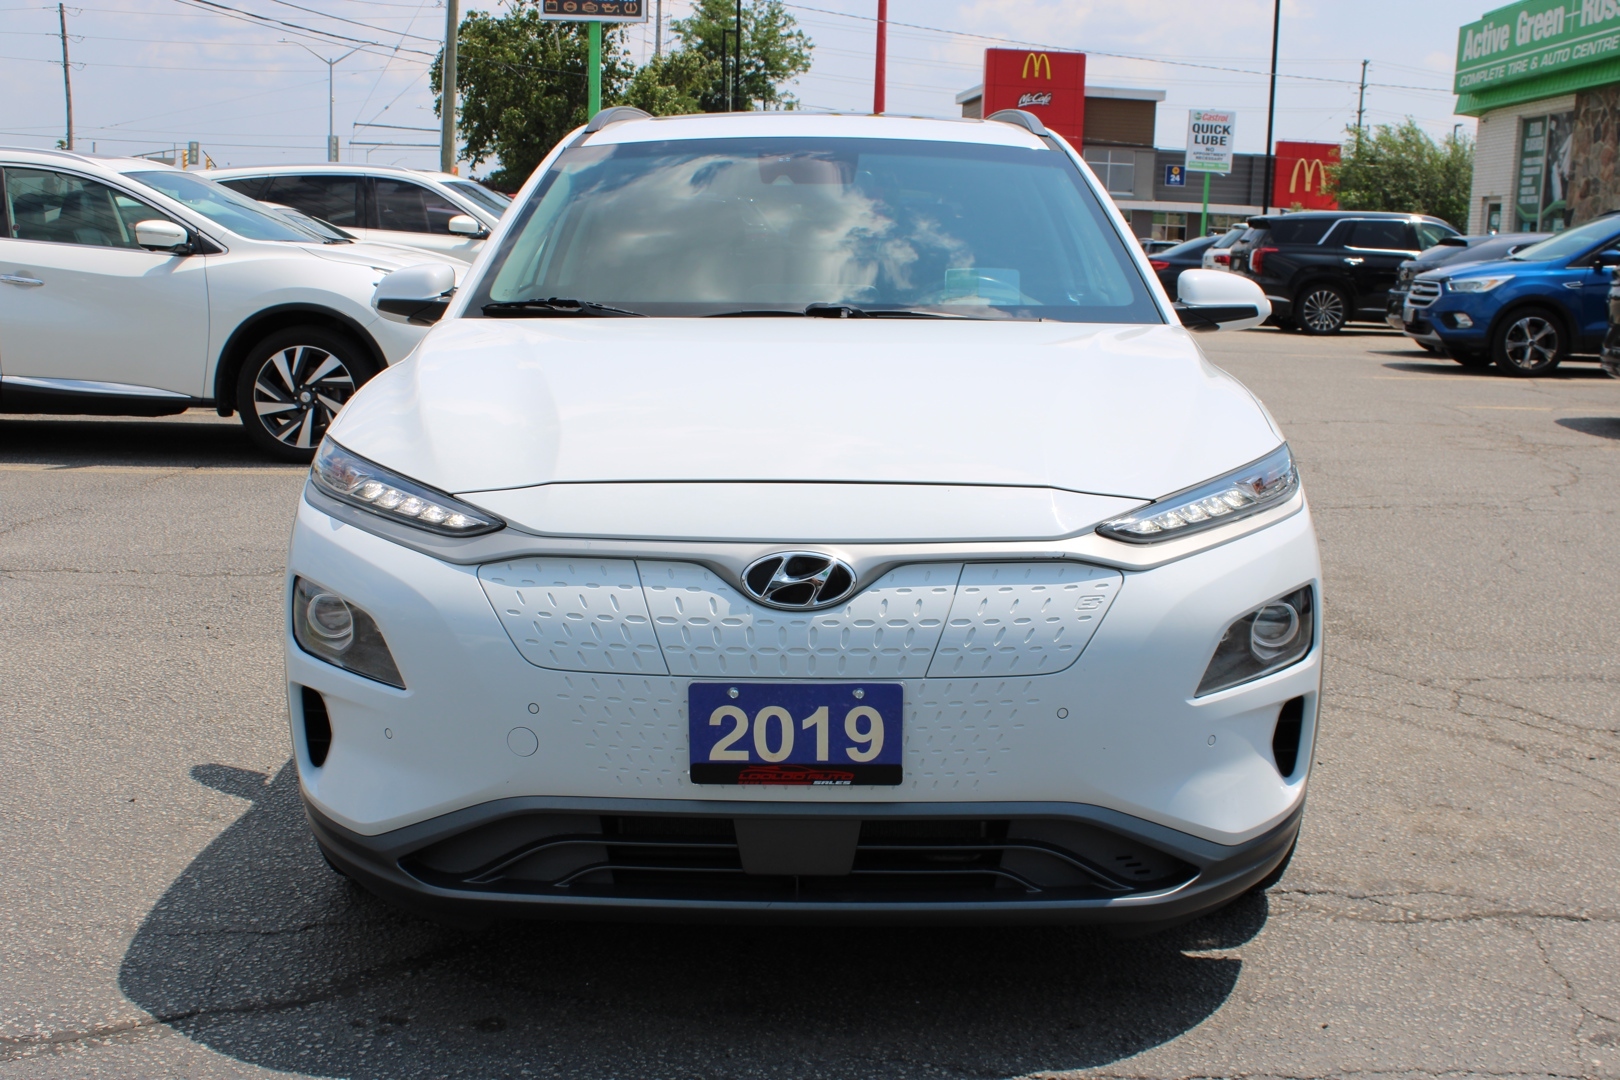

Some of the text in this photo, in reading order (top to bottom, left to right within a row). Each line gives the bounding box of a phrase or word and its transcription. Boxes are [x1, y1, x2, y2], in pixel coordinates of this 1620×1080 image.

[1462, 22, 1510, 62] Active
[1459, 34, 1620, 88] COMPLETE TIRE & AUTO CENTRE
[1202, 113, 1229, 122] Castrol
[1192, 123, 1231, 135] QUICK
[1194, 135, 1227, 145] LUBE
[1170, 174, 1180, 182] 24
[708, 704, 885, 763] 2019
